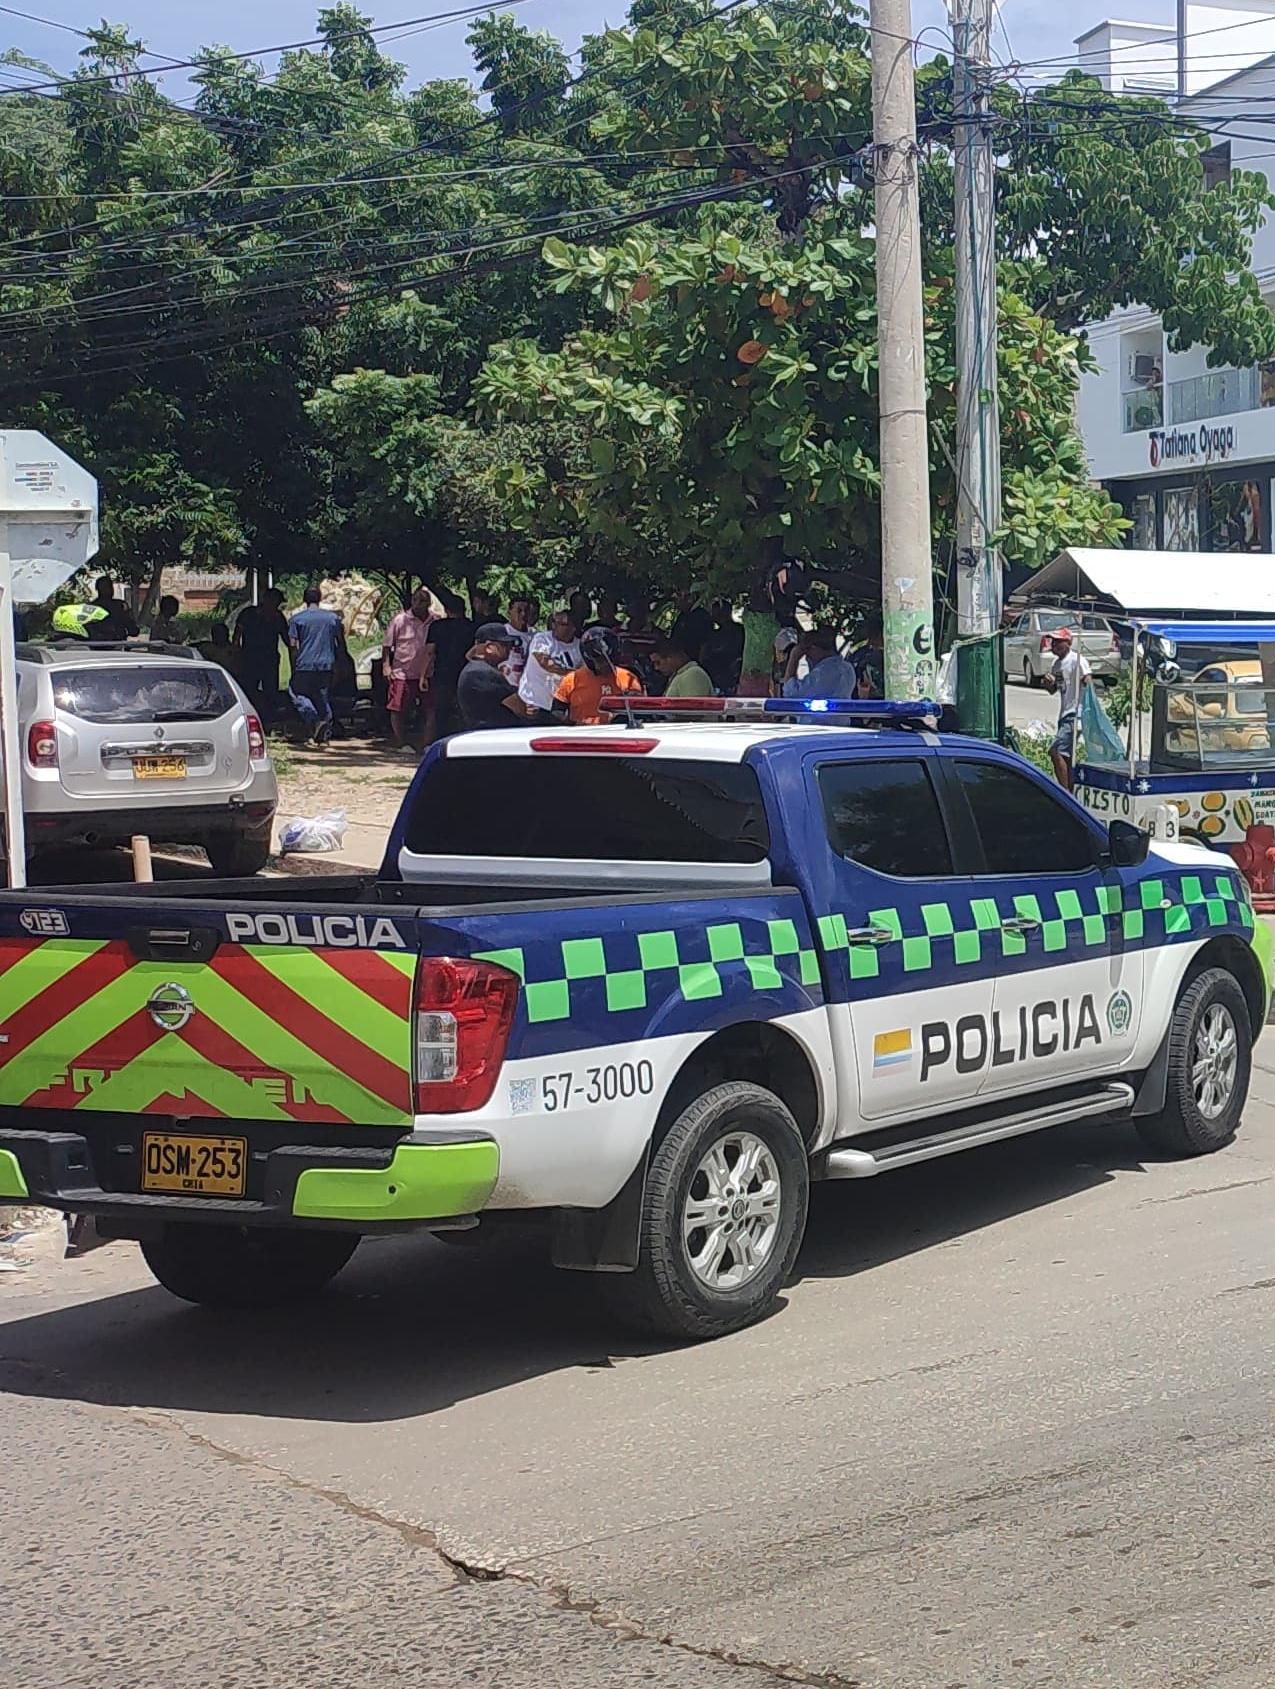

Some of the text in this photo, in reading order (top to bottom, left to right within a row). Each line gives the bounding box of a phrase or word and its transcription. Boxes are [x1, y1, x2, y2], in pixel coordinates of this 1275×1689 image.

[1159, 428, 1196, 459] Tatiana
[1199, 424, 1234, 460] Oyaga
[1074, 785, 1130, 815] CRISTO
[32, 912, 66, 931] 123
[920, 994, 1102, 1082] POLICIA
[542, 1059, 654, 1111] 57-3000
